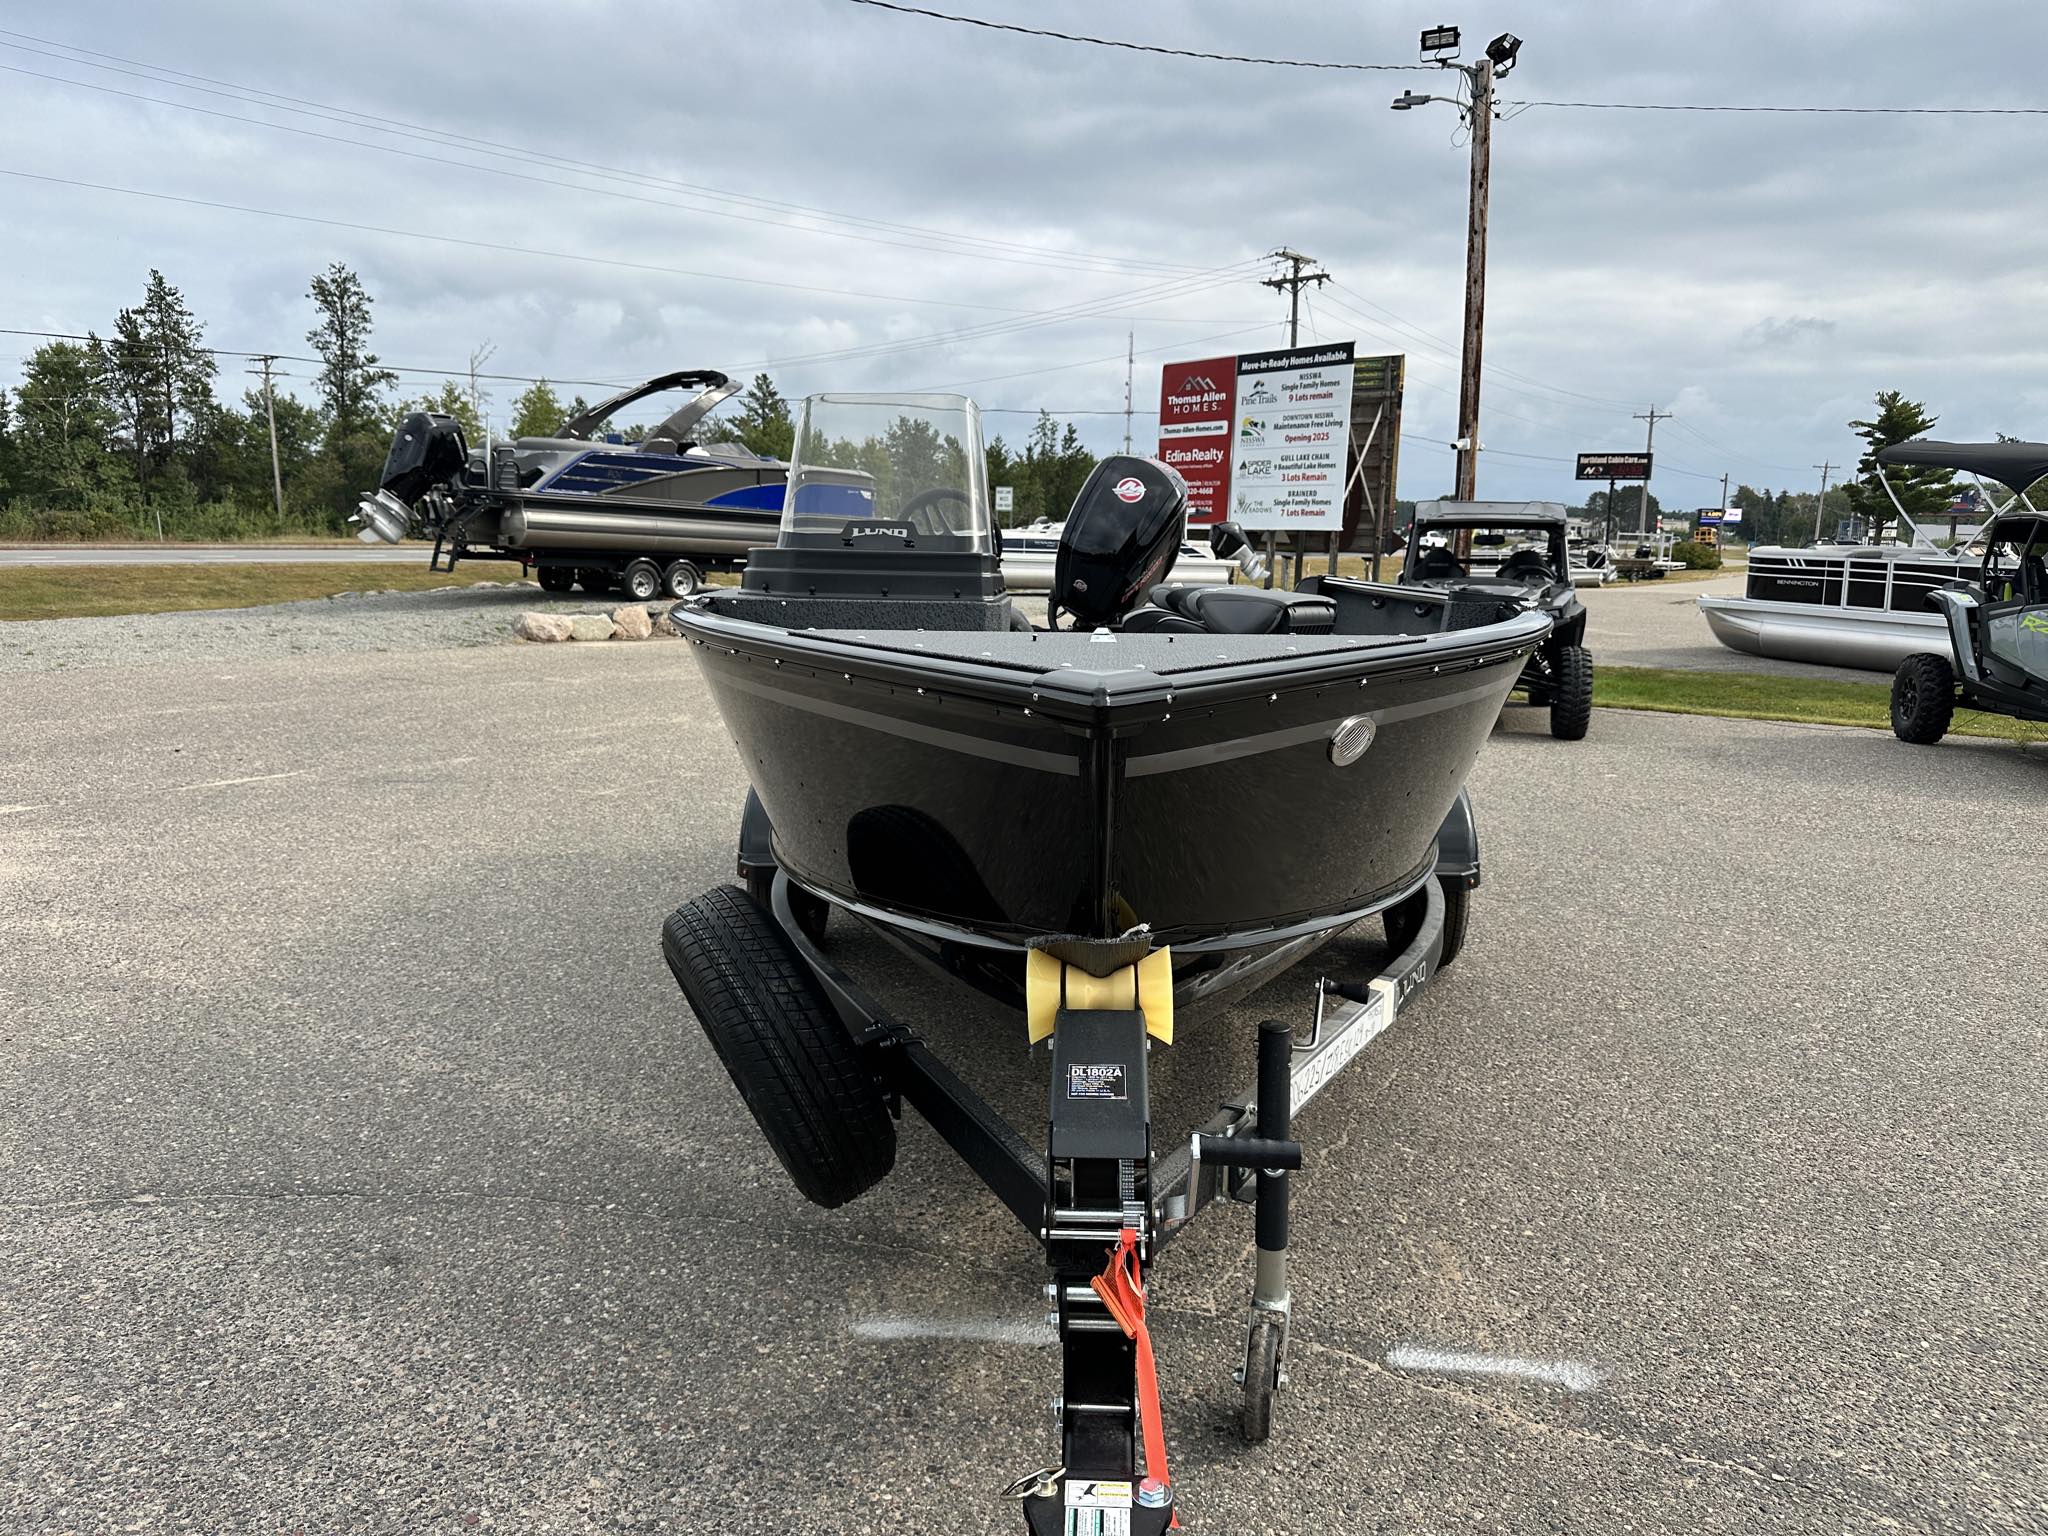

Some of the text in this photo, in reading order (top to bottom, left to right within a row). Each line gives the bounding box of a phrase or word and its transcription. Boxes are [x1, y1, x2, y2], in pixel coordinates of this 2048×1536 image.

[1241, 350, 1348, 371] Move-in-Ready Homes Available
[1299, 372, 1322, 380] NISSWA
[1281, 380, 1340, 392] Single Family Homes
[1168, 391, 1226, 405] Thomas Allen
[1241, 394, 1278, 406] Pine Trails
[1289, 391, 1334, 403] 9 Lots remain
[1173, 402, 1218, 414] HOMES
[1283, 413, 1313, 421] DOWNTOWN
[1274, 419, 1343, 430] Maintenance Free Living
[1285, 432, 1330, 443] Opening 2025
[1166, 448, 1224, 463] Edina Realty
[1247, 466, 1272, 475] LAKE
[1317, 461, 1336, 469] Homes
[1287, 473, 1300, 481] Lots
[1301, 472, 1327, 480] Remain
[1274, 499, 1290, 507] Single
[1291, 499, 1311, 507] Family
[1300, 508, 1326, 516] Remain
[851, 527, 908, 538] LUND
[1776, 579, 1819, 587] BENNINGTON
[1071, 1068, 1123, 1077] DL1802A
